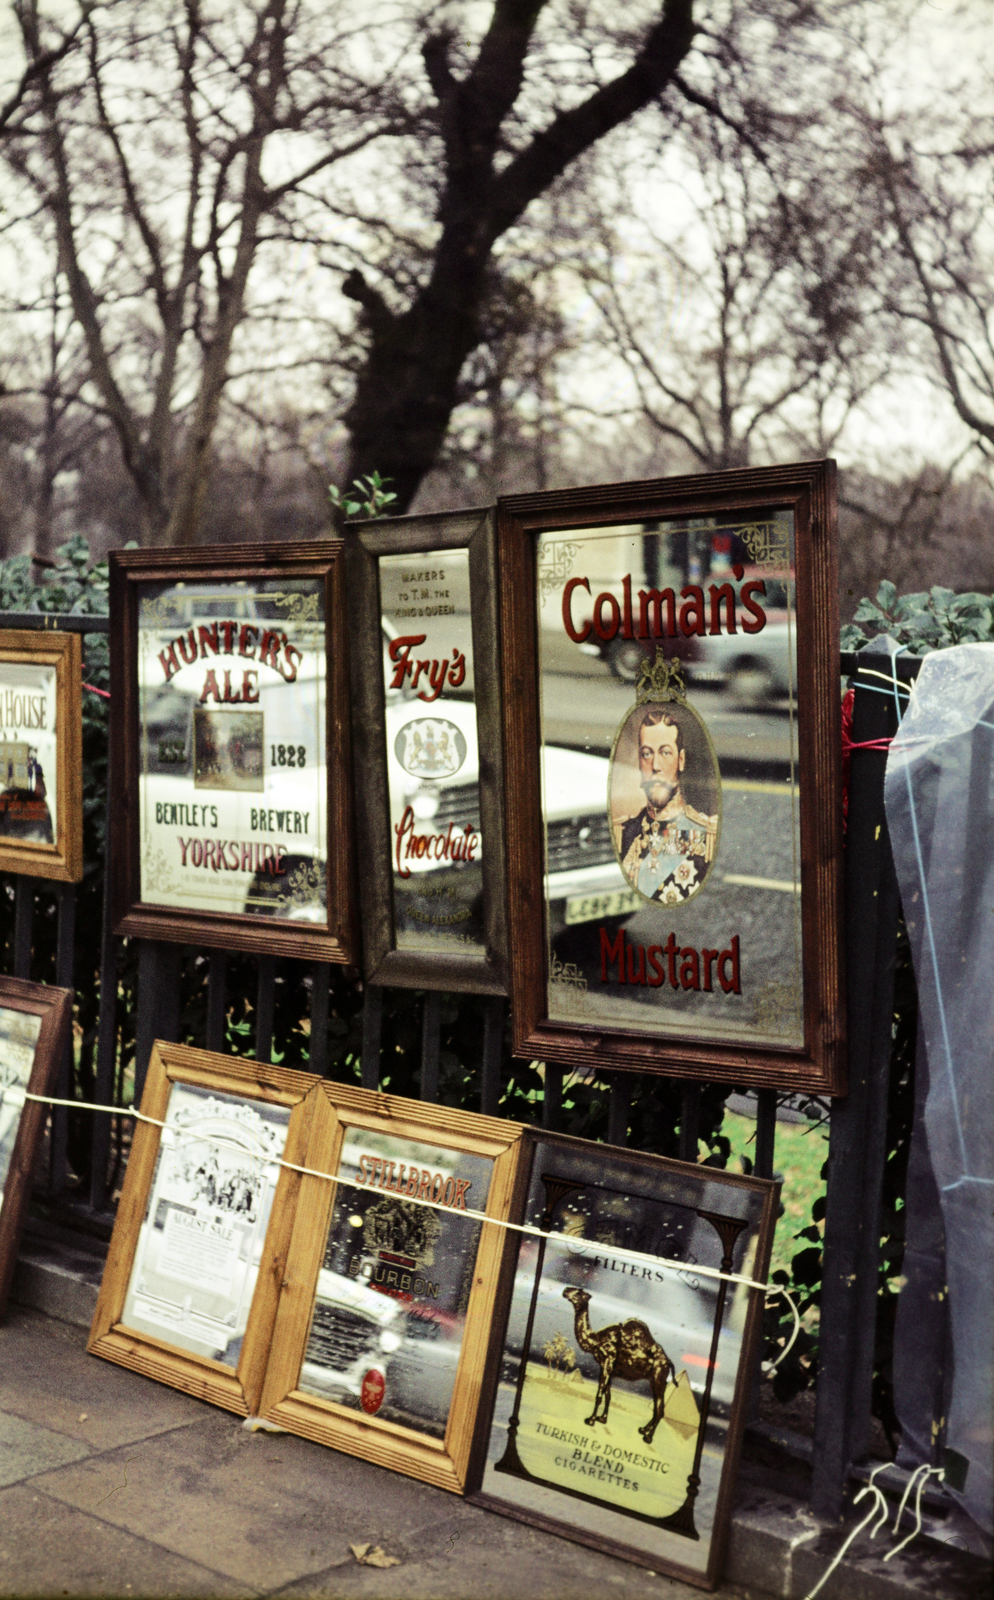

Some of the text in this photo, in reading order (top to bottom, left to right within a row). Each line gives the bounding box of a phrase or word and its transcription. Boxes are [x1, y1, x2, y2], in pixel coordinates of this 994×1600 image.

[398, 592, 409, 601] TO
[434, 589, 450, 598] THE
[401, 569, 446, 583] MAKERS
[425, 605, 456, 617] QUEEN
[561, 563, 767, 644] Colman's
[157, 620, 304, 683] HUNTER'S
[388, 634, 466, 702] Fry's
[199, 668, 261, 705] ALE
[5, 689, 48, 731] HOUSE
[270, 744, 307, 769] 1828
[155, 801, 310, 834] BENTLEYS BREWERY
[177, 836, 289, 877] YORKSHIRE
[395, 805, 479, 879] Chocolate
[599, 927, 742, 995] Mustard
[355, 1154, 472, 1211] STILLBROOK
[171, 1212, 235, 1242] AUGUST SALE
[348, 1257, 440, 1300] BOURBON
[593, 1255, 665, 1283] FILTERS
[535, 1422, 671, 1475] TURKISH & DOMESTIC
[572, 1448, 625, 1475] BLEND
[554, 1456, 639, 1492] CIGARETTES
